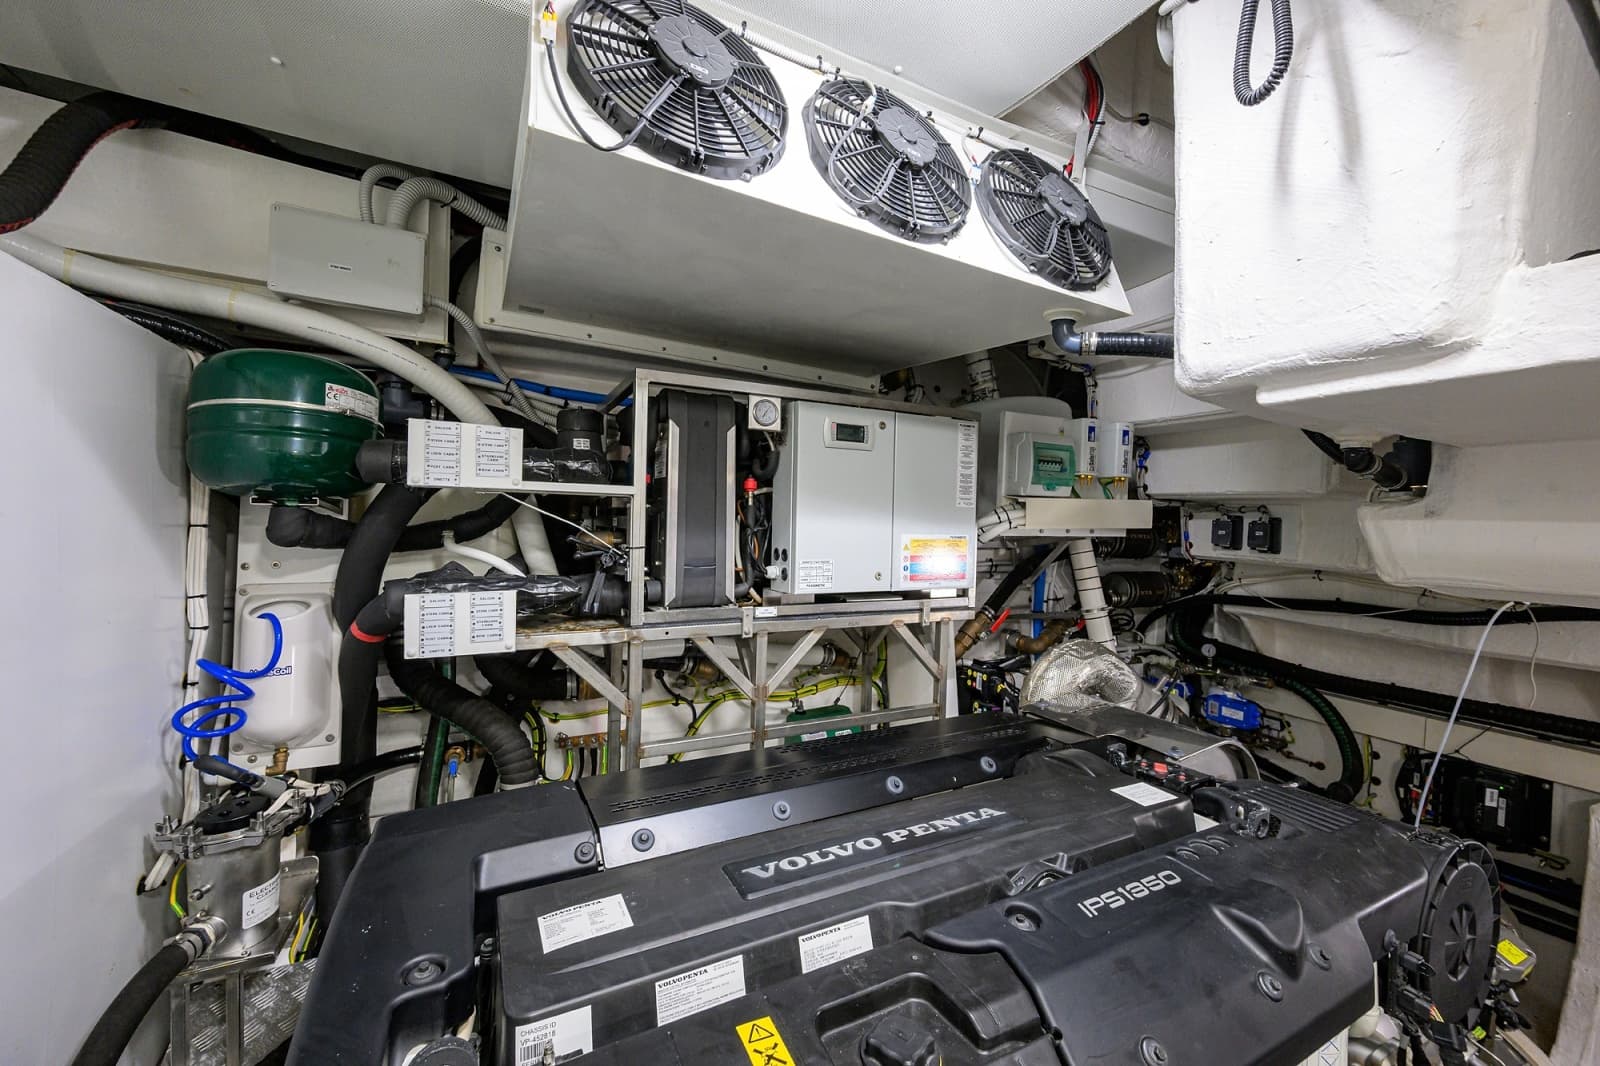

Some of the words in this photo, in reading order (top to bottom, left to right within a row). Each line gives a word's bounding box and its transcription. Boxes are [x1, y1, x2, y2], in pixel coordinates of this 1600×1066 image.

[741, 836, 882, 879] VOLVO
[882, 807, 1007, 844] PENTA
[1077, 870, 1182, 918] IPS1350
[520, 1023, 549, 1037] CHASSIS
